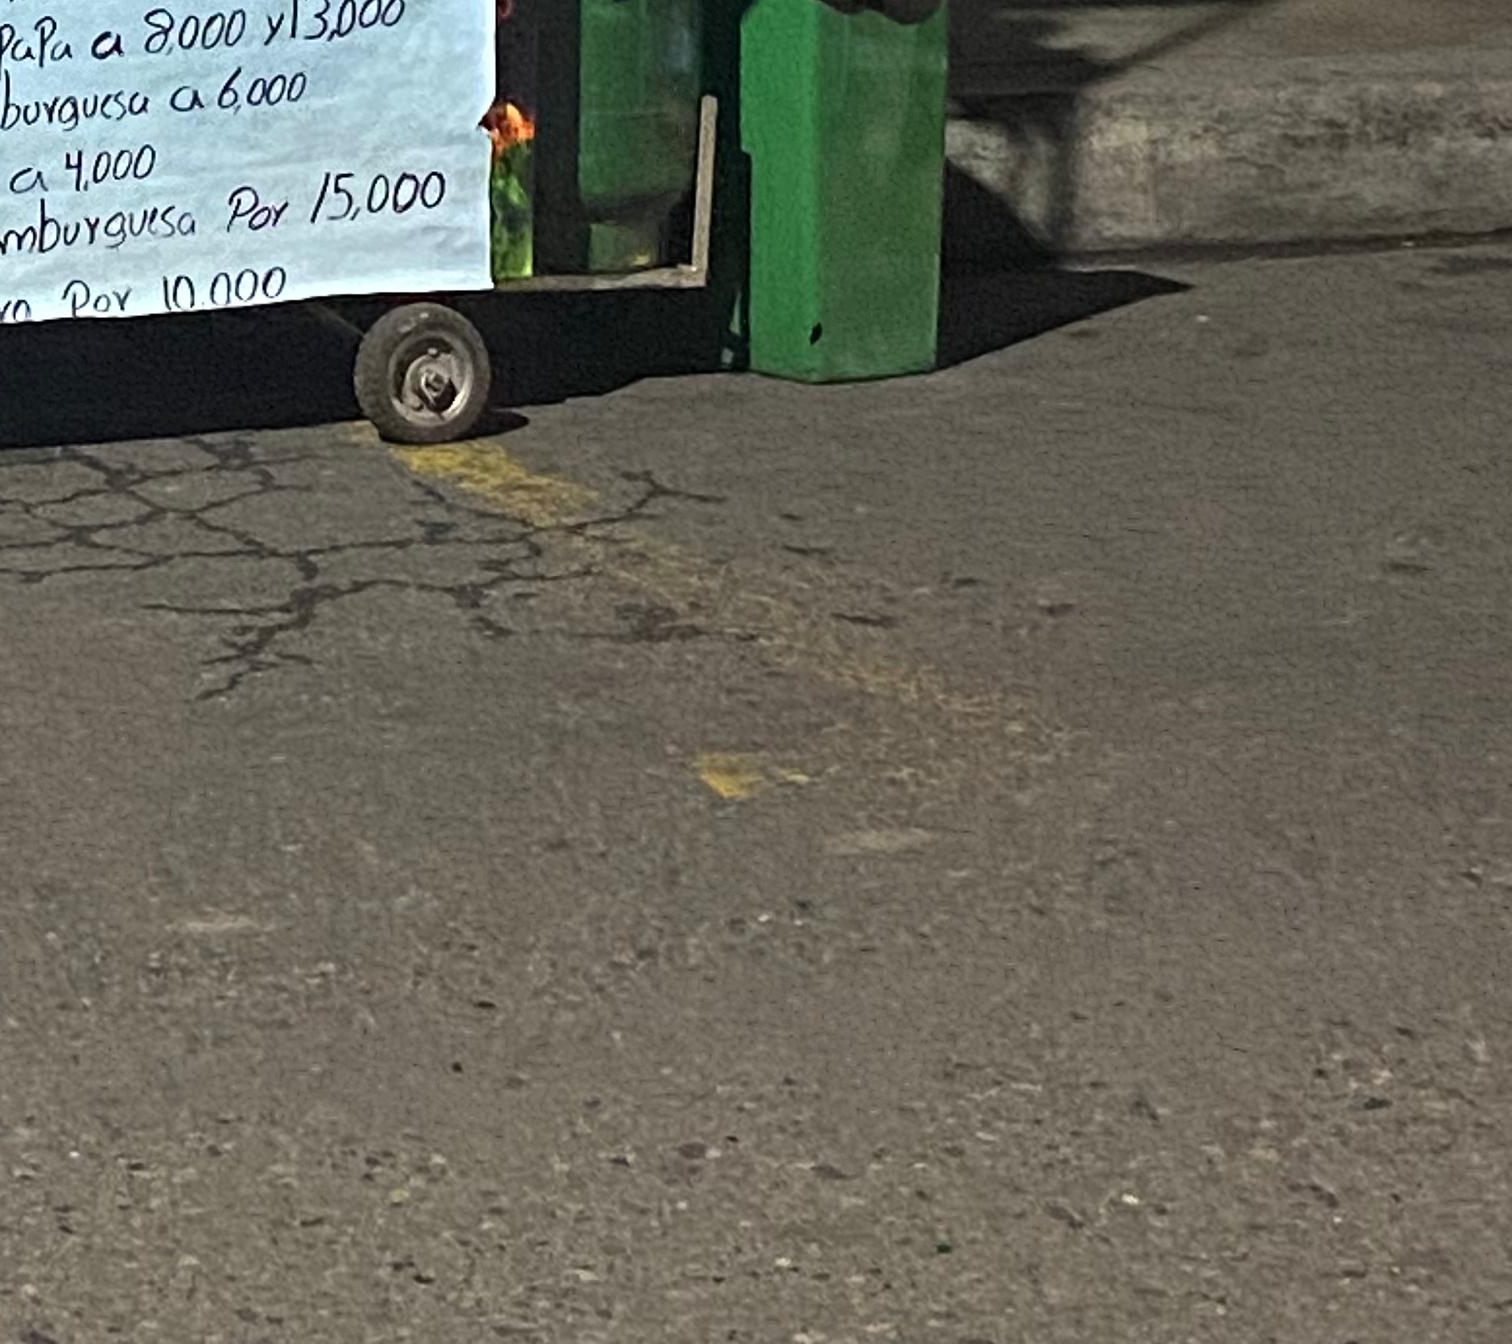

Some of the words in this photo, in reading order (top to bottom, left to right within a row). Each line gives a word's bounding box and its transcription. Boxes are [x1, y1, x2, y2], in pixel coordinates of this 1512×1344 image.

[91, 29, 126, 60] a
[169, 84, 206, 112] a
[9, 167, 46, 195] a
[226, 185, 289, 234] Por
[61, 279, 133, 319] Por
